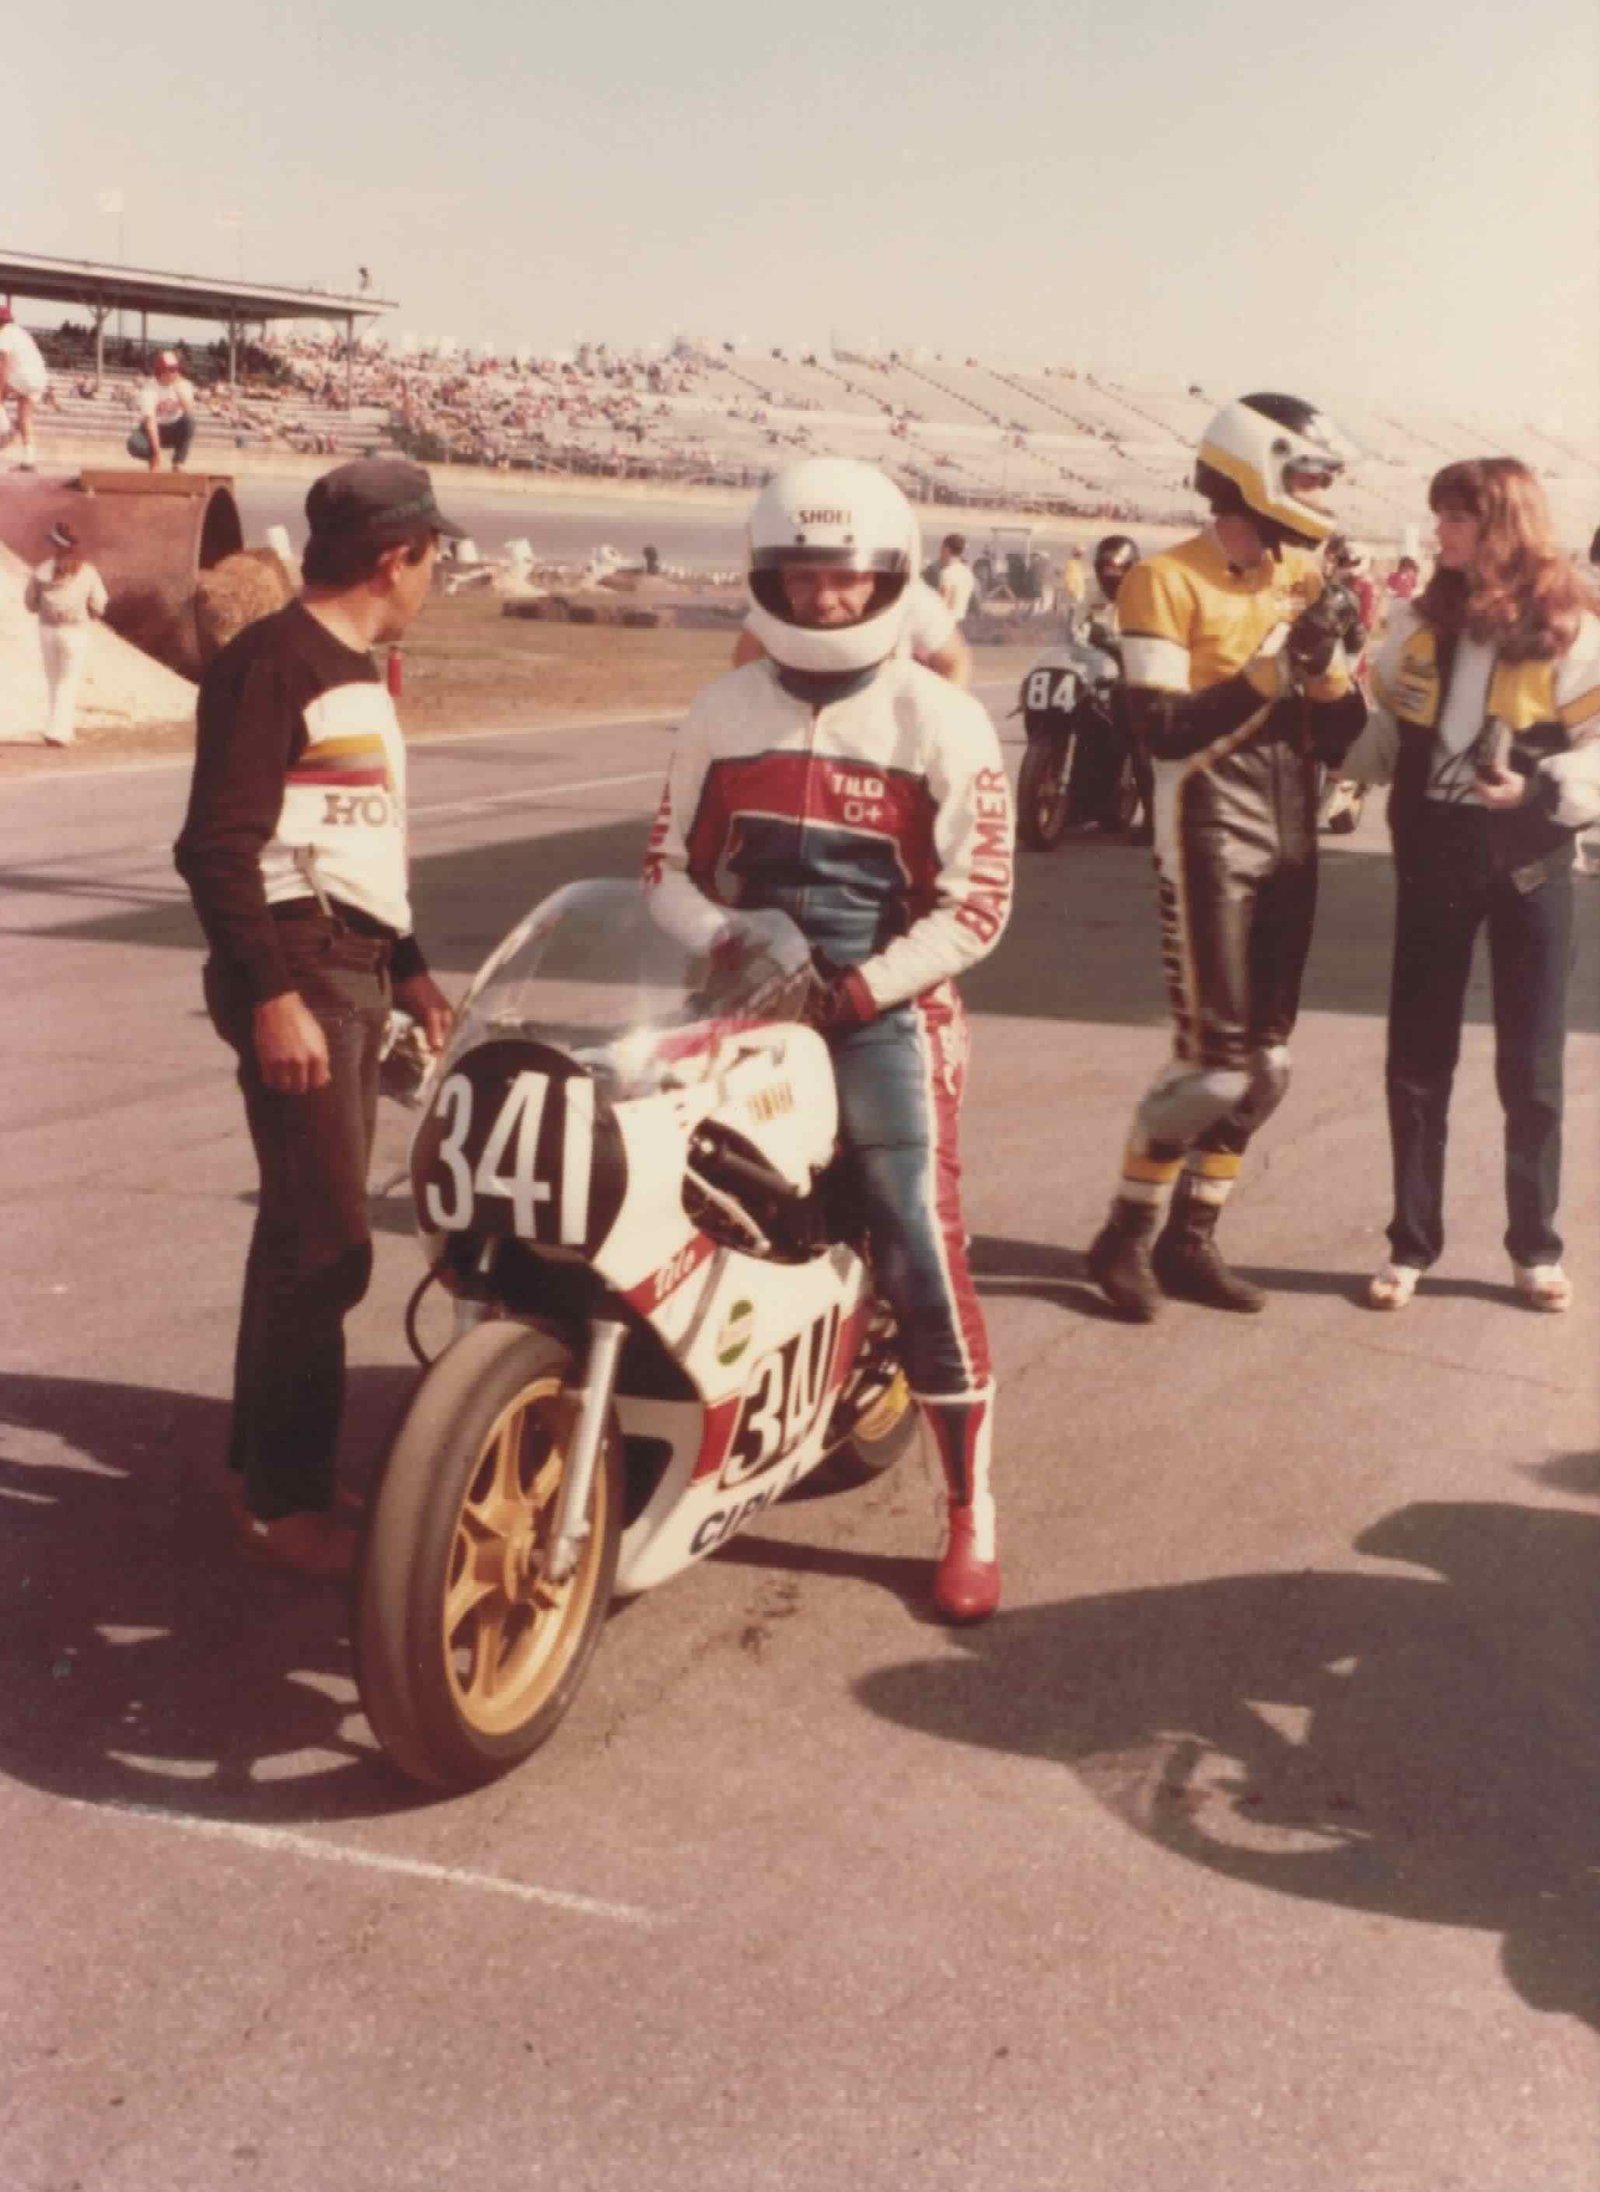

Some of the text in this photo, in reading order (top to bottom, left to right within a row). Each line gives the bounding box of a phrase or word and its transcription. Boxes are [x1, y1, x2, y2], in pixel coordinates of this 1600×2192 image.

[1027, 671, 1077, 713] 84
[321, 793, 400, 828] HO
[954, 767, 1011, 945] BAUMER
[425, 1069, 595, 1245] 341
[722, 1302, 840, 1488] 341
